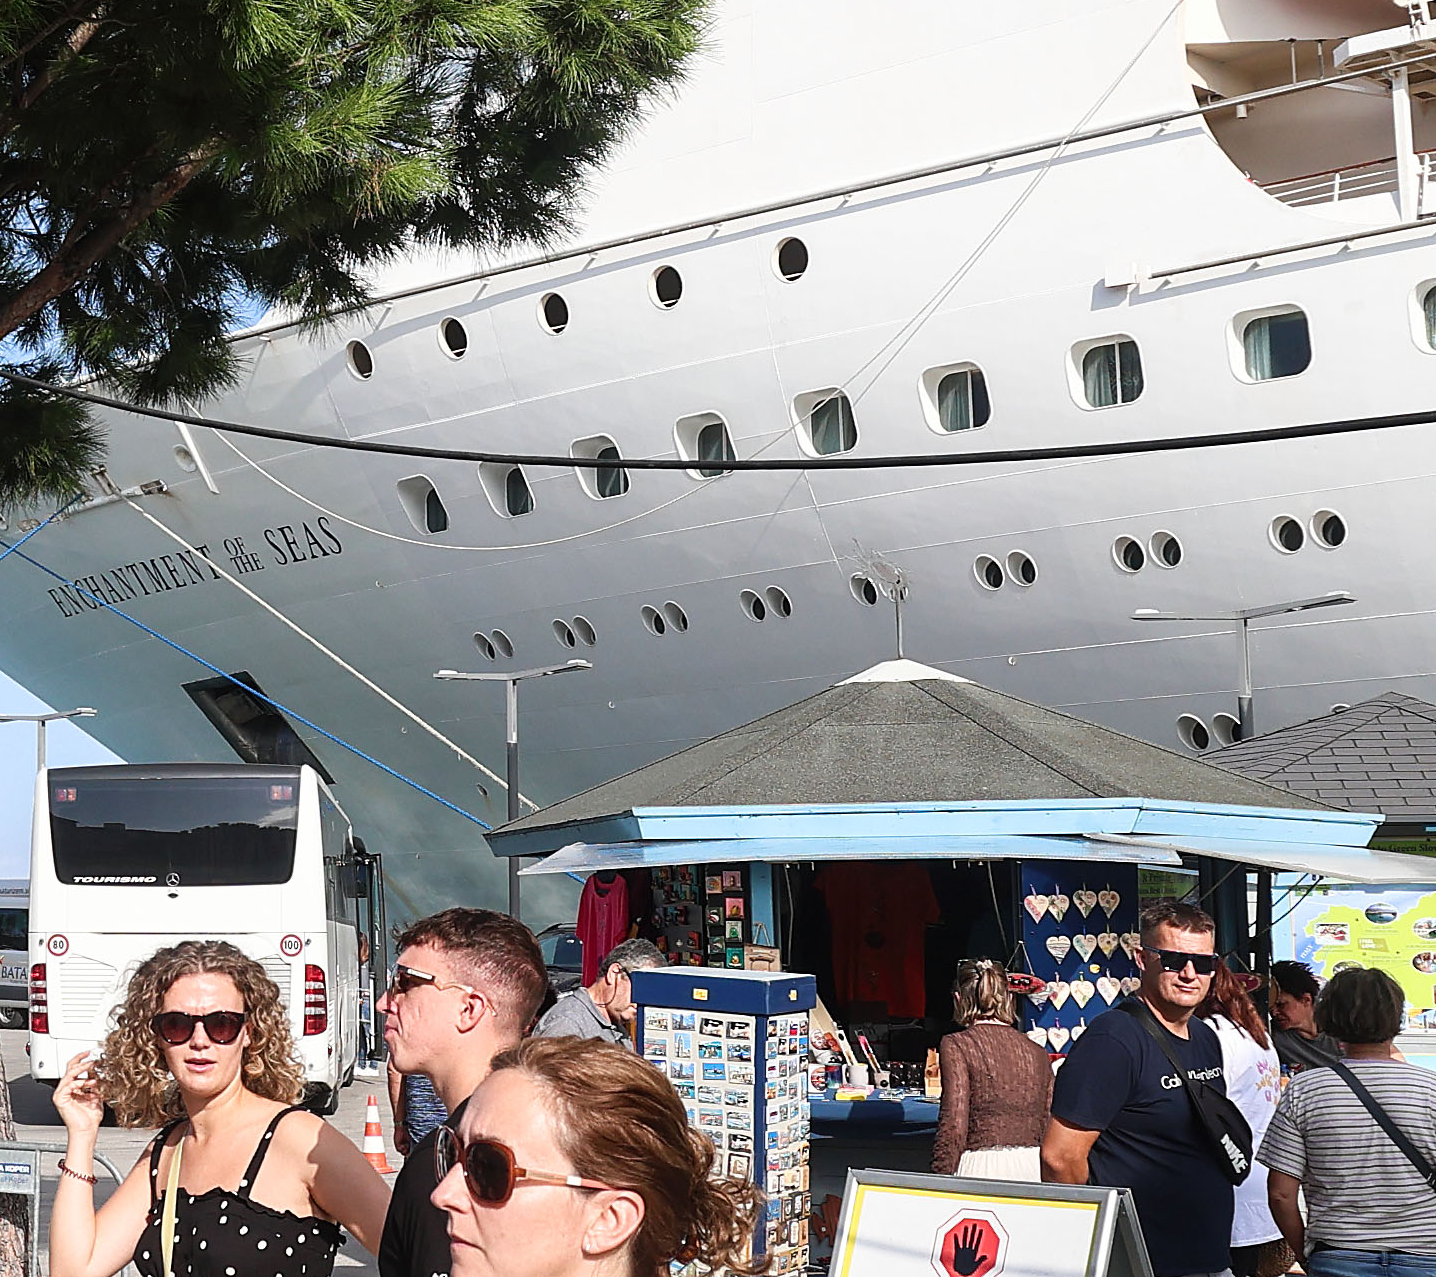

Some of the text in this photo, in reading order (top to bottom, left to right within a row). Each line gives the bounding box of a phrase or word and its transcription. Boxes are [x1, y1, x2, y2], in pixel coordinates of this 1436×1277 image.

[47, 516, 342, 618] ENCHANTMENT OF THE SEAS
[52, 940, 64, 950] 80
[282, 939, 300, 951] 100
[1, 966, 28, 979] BATA
[1220, 1133, 1249, 1174] NIKE
[5, 1164, 30, 1173] KOPER
